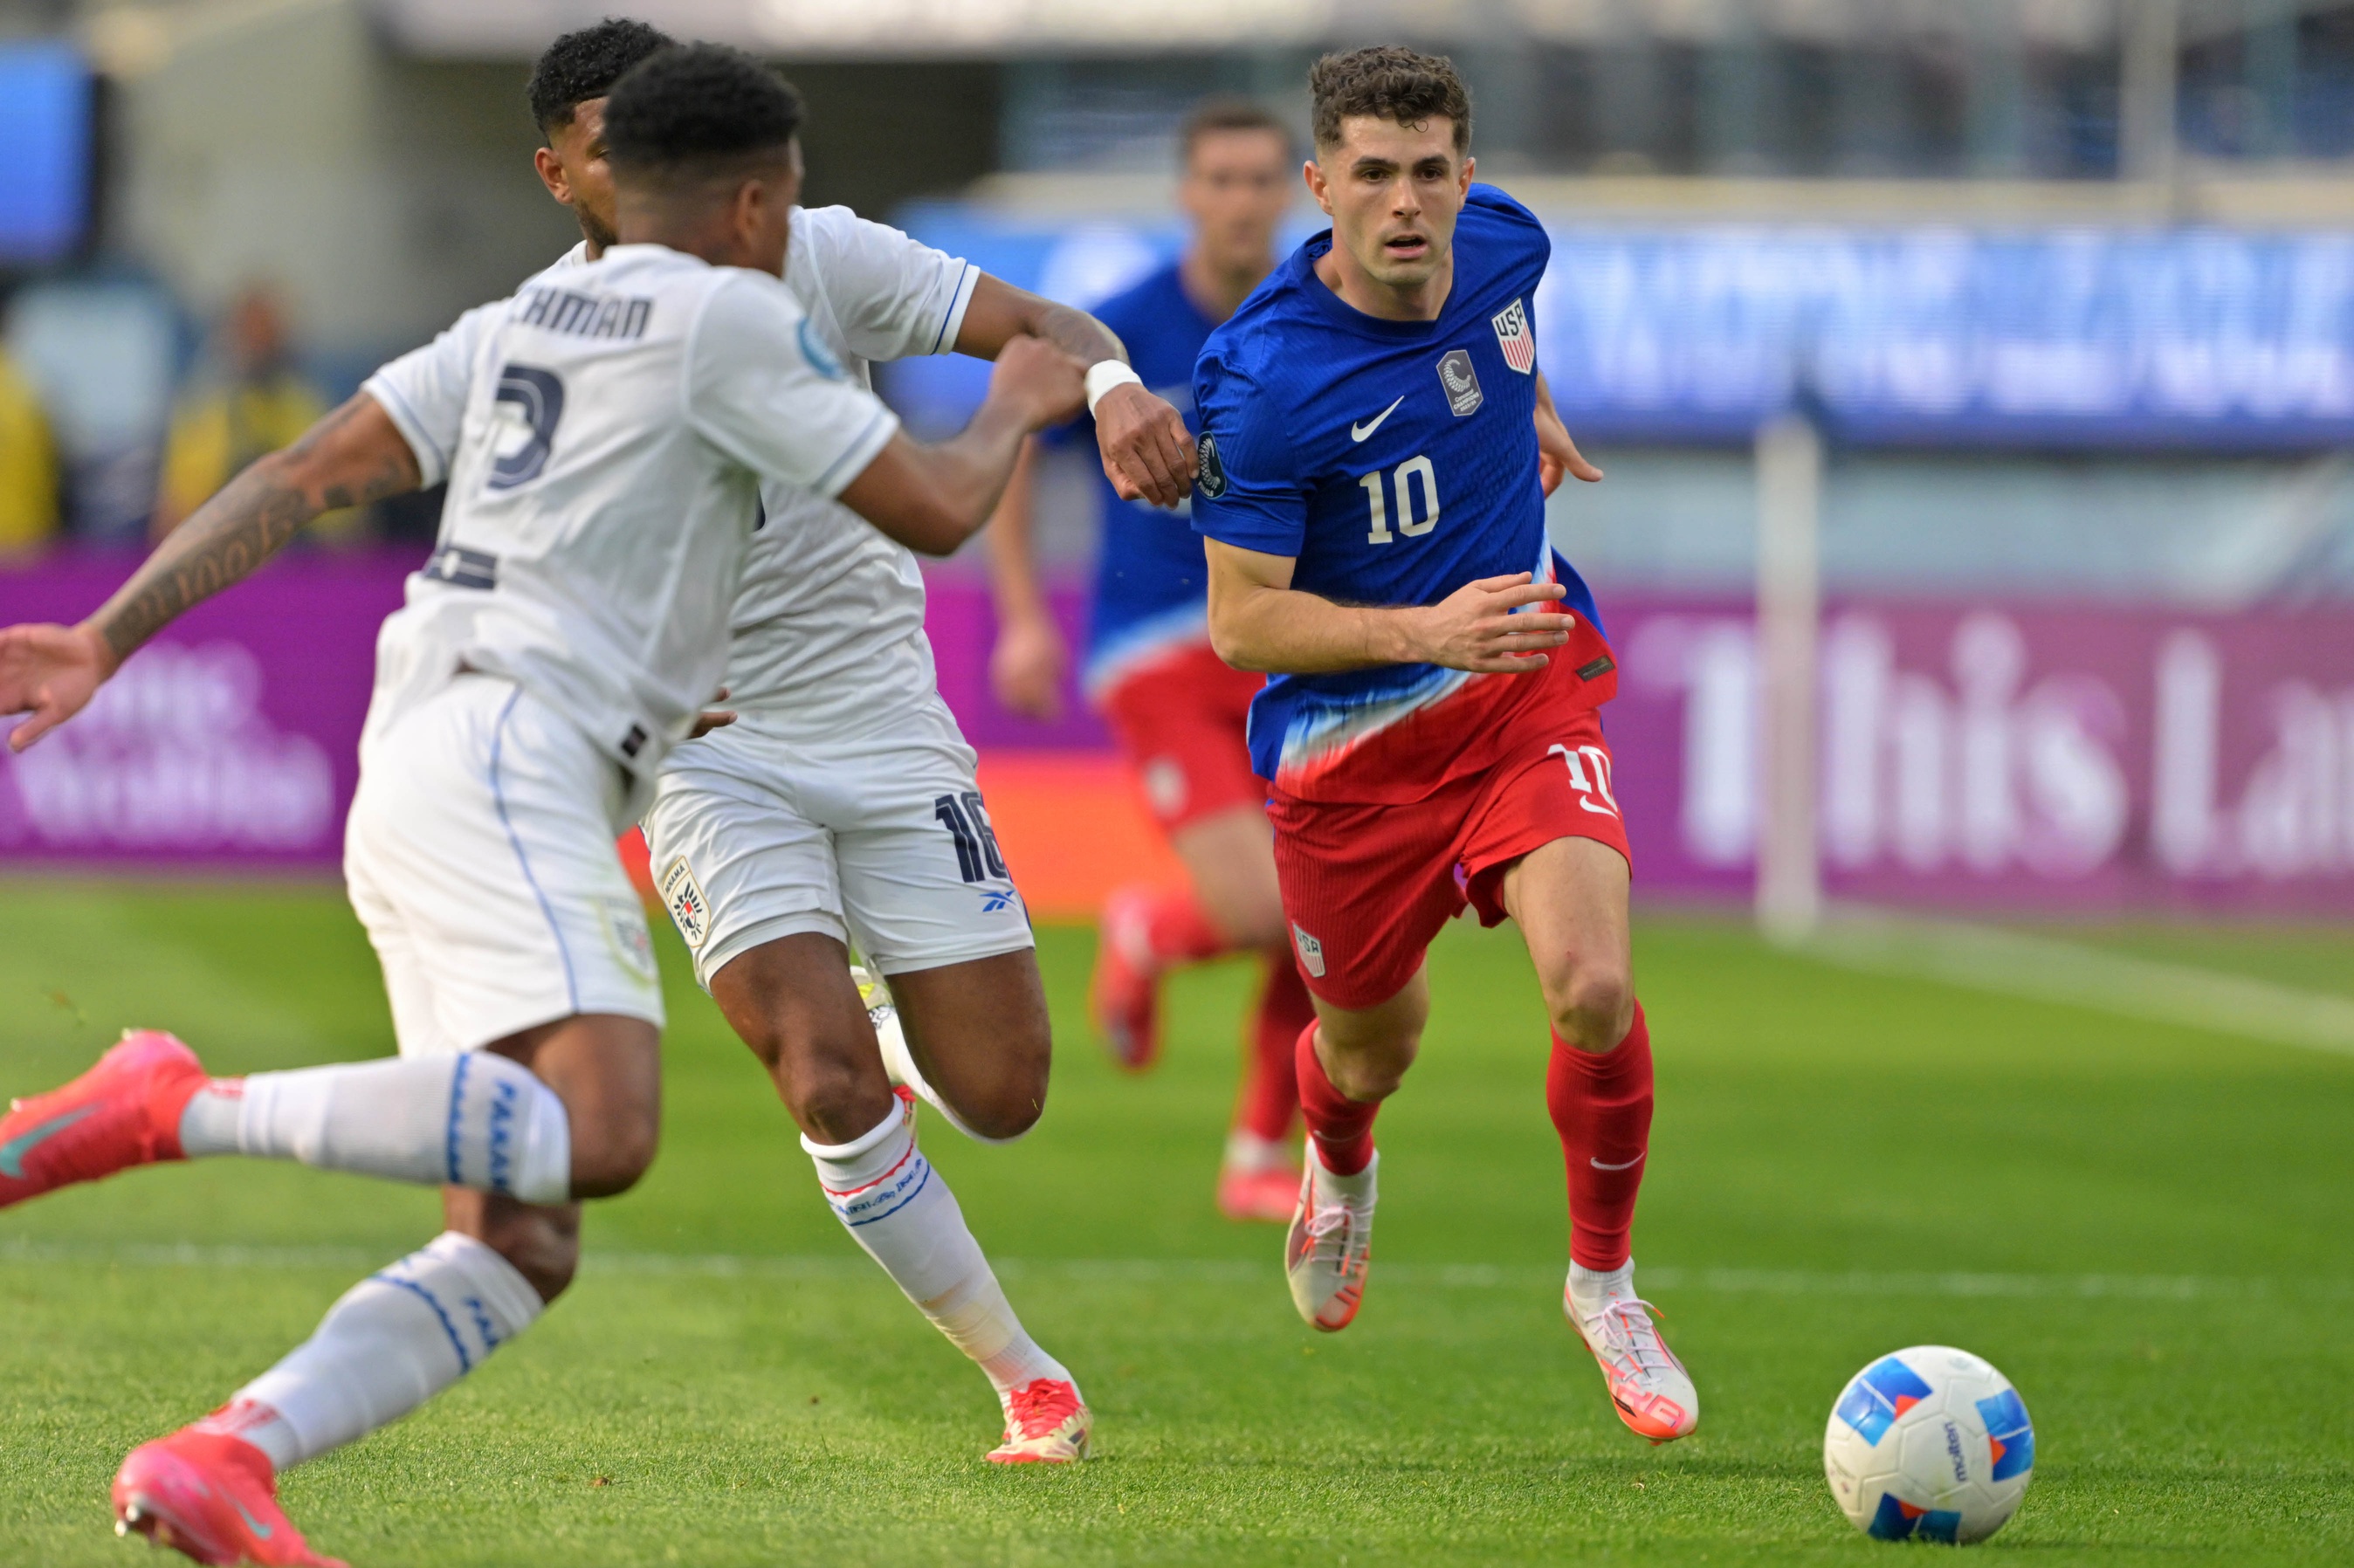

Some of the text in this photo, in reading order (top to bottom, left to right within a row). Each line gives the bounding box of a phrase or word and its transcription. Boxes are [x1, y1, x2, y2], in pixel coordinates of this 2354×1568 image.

[1494, 303, 1524, 336] USA
[1453, 392, 1480, 409] CHAMPIONS
[1359, 455, 1439, 544] 10
[1547, 743, 1618, 813] 10
[1628, 613, 2354, 877] This La
[935, 792, 1008, 883] 16
[1944, 1422, 1967, 1482] molten
